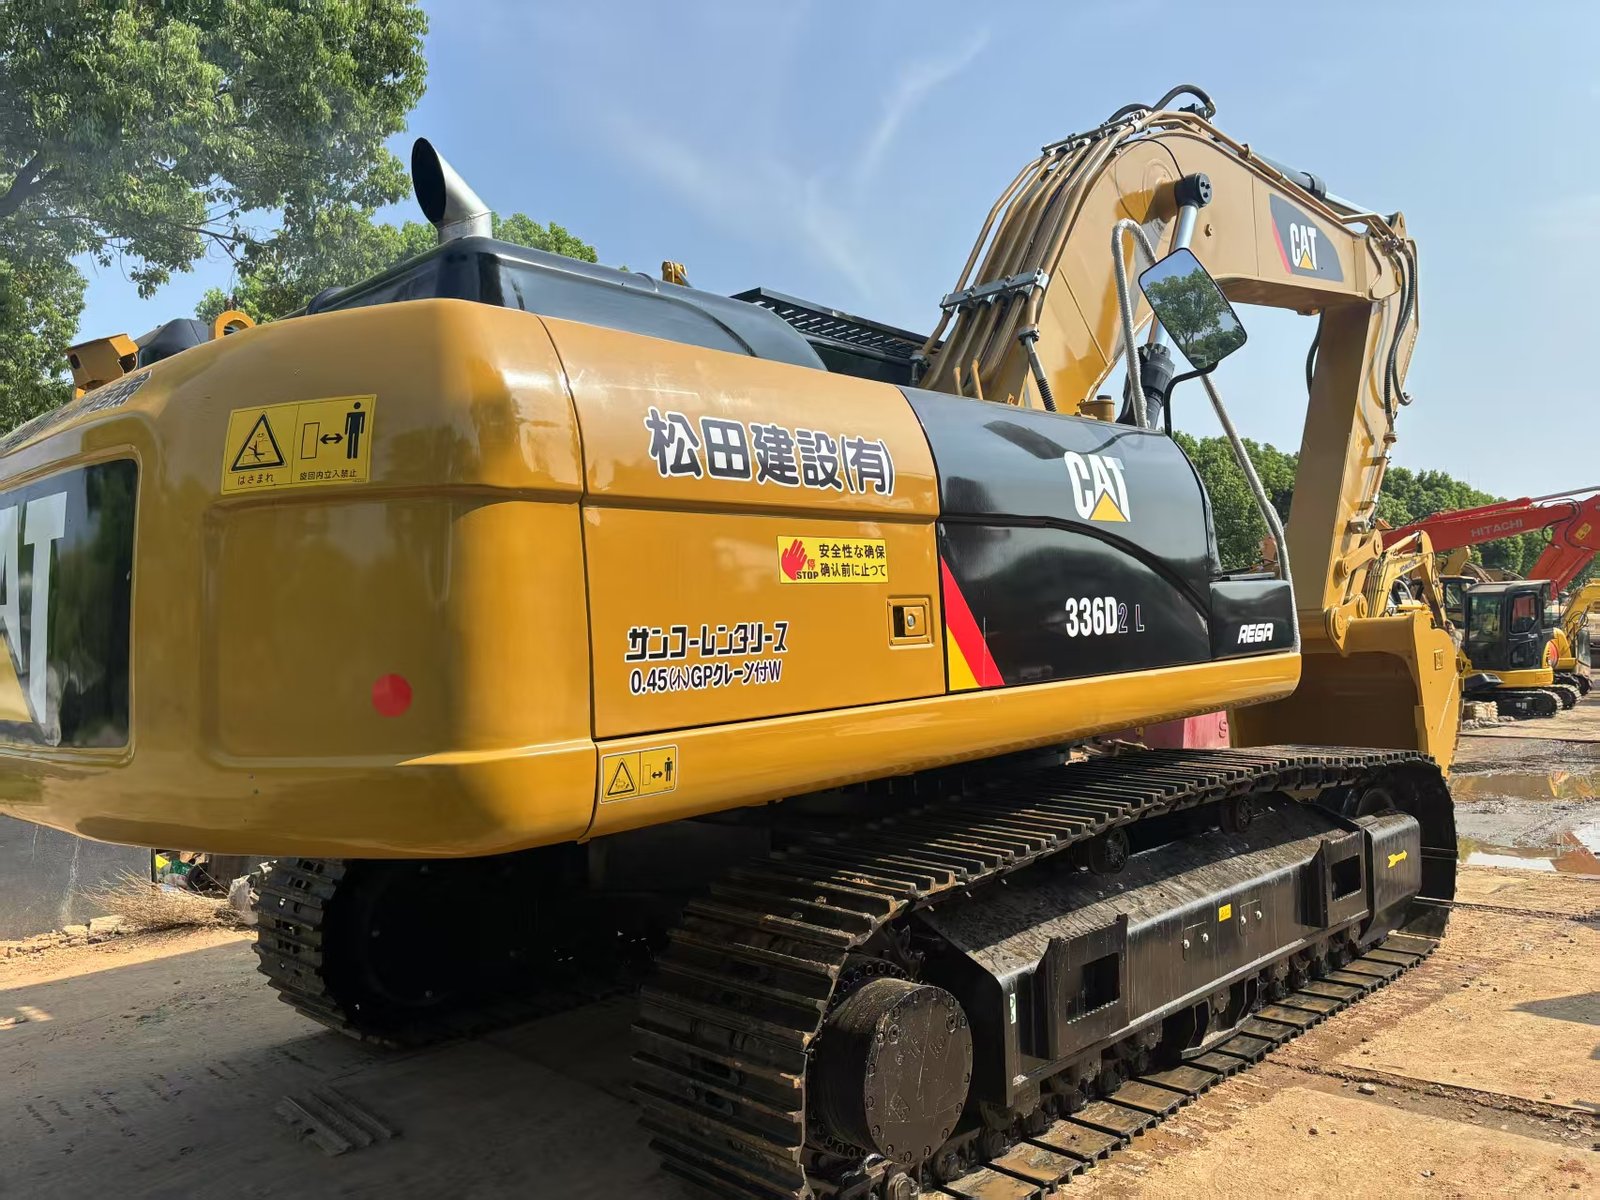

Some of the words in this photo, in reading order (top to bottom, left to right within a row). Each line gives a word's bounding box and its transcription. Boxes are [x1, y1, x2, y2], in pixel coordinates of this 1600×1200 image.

[1290, 222, 1317, 270] CAT
[645, 407, 893, 495] 松田建設(有)
[237, 472, 275, 486] はさまれ
[1064, 451, 1131, 522] CAT
[1471, 519, 1524, 537] HITACHI
[796, 571, 819, 580] STOP
[1135, 604, 1145, 632] L
[626, 621, 788, 662] サンコーレンタリース
[1237, 622, 1274, 645] REGA
